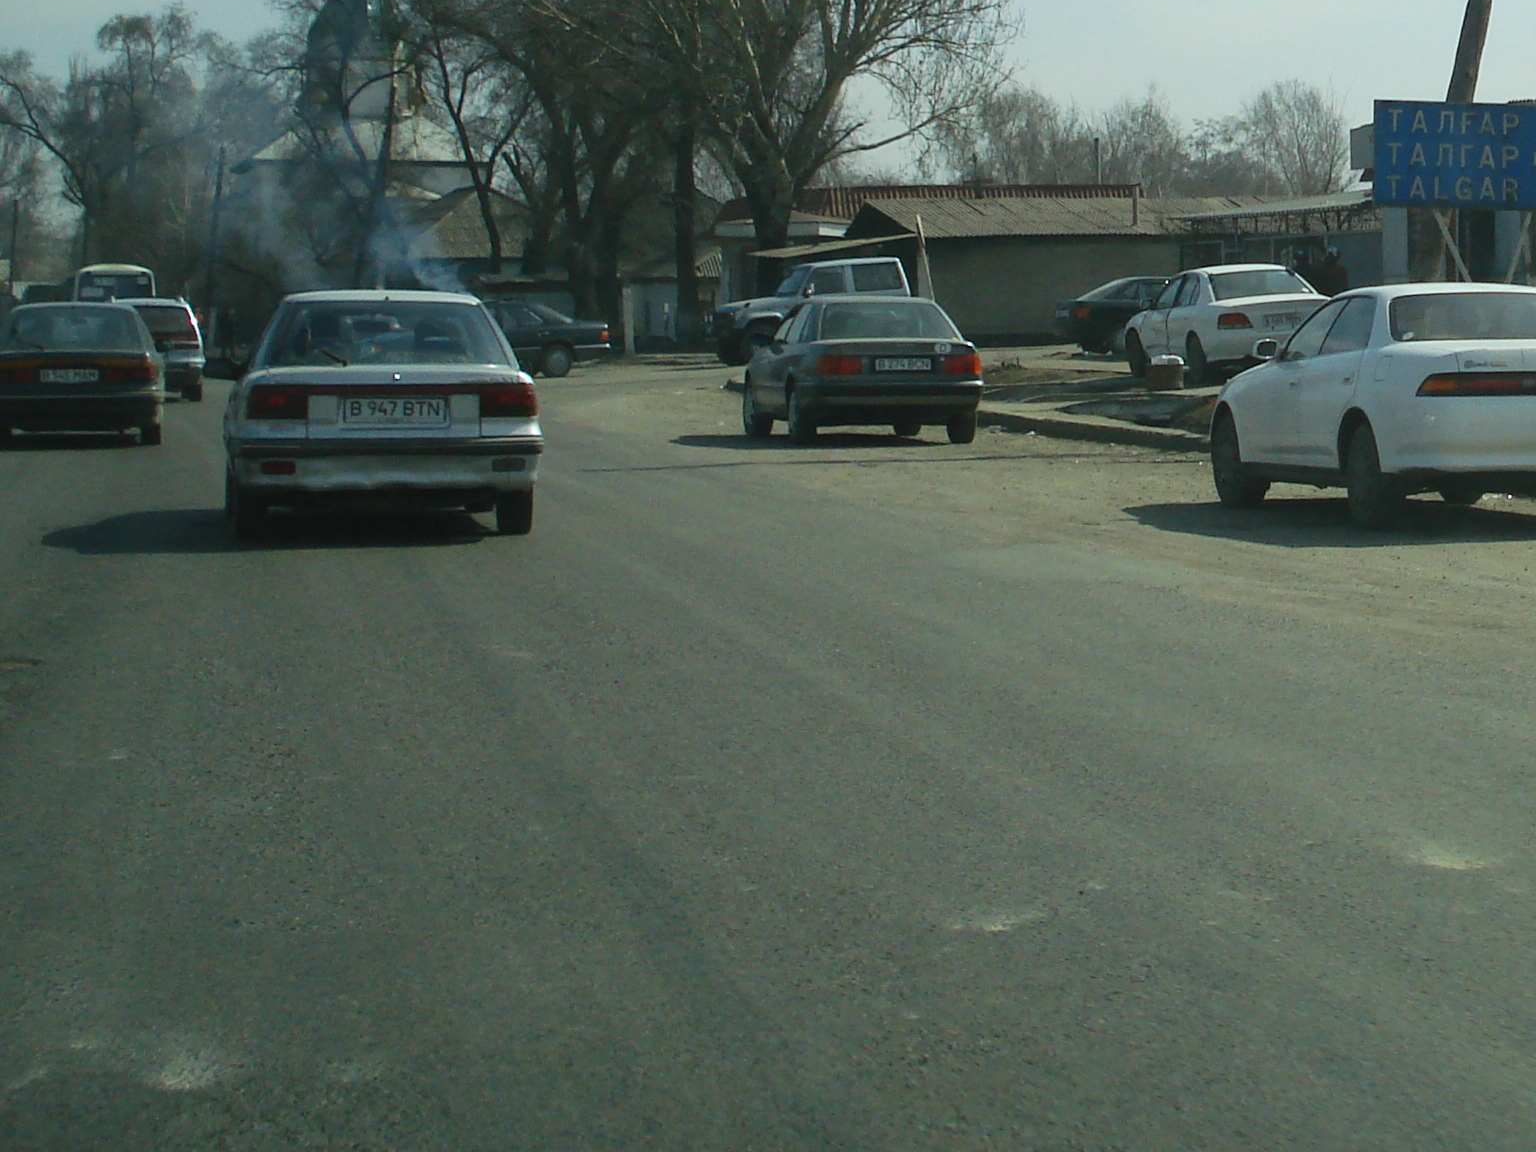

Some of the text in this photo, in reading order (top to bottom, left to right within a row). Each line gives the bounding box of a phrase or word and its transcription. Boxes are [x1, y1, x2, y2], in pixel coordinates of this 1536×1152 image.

[1387, 143, 1519, 170] ТАЛГАР
[1386, 176, 1518, 202] TALGAR
[350, 401, 440, 417] B 947 BTN
